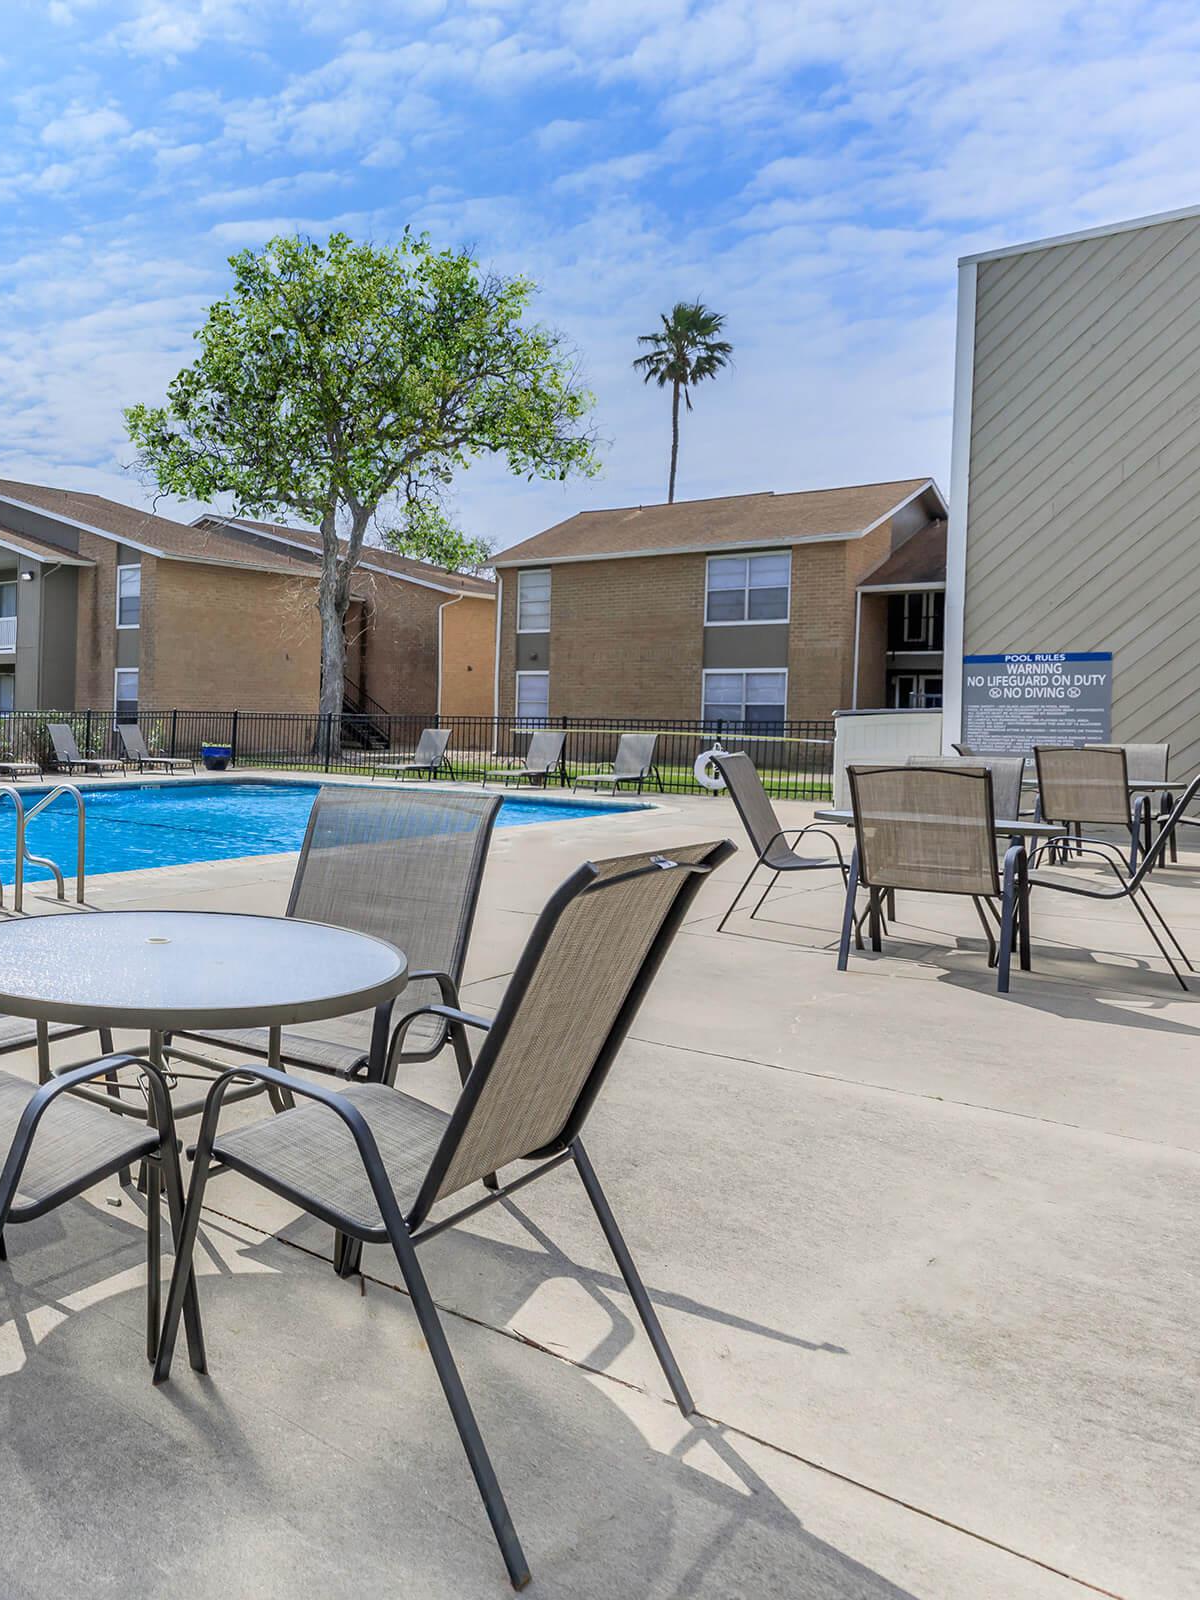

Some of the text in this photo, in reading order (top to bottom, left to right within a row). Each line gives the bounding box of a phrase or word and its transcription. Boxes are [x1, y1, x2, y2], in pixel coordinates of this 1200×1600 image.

[1007, 663, 1062, 674] WARNING
[967, 674, 1106, 687] NO LIFEGUARD ON DUTY
[1003, 687, 1065, 698] NO DIVING
